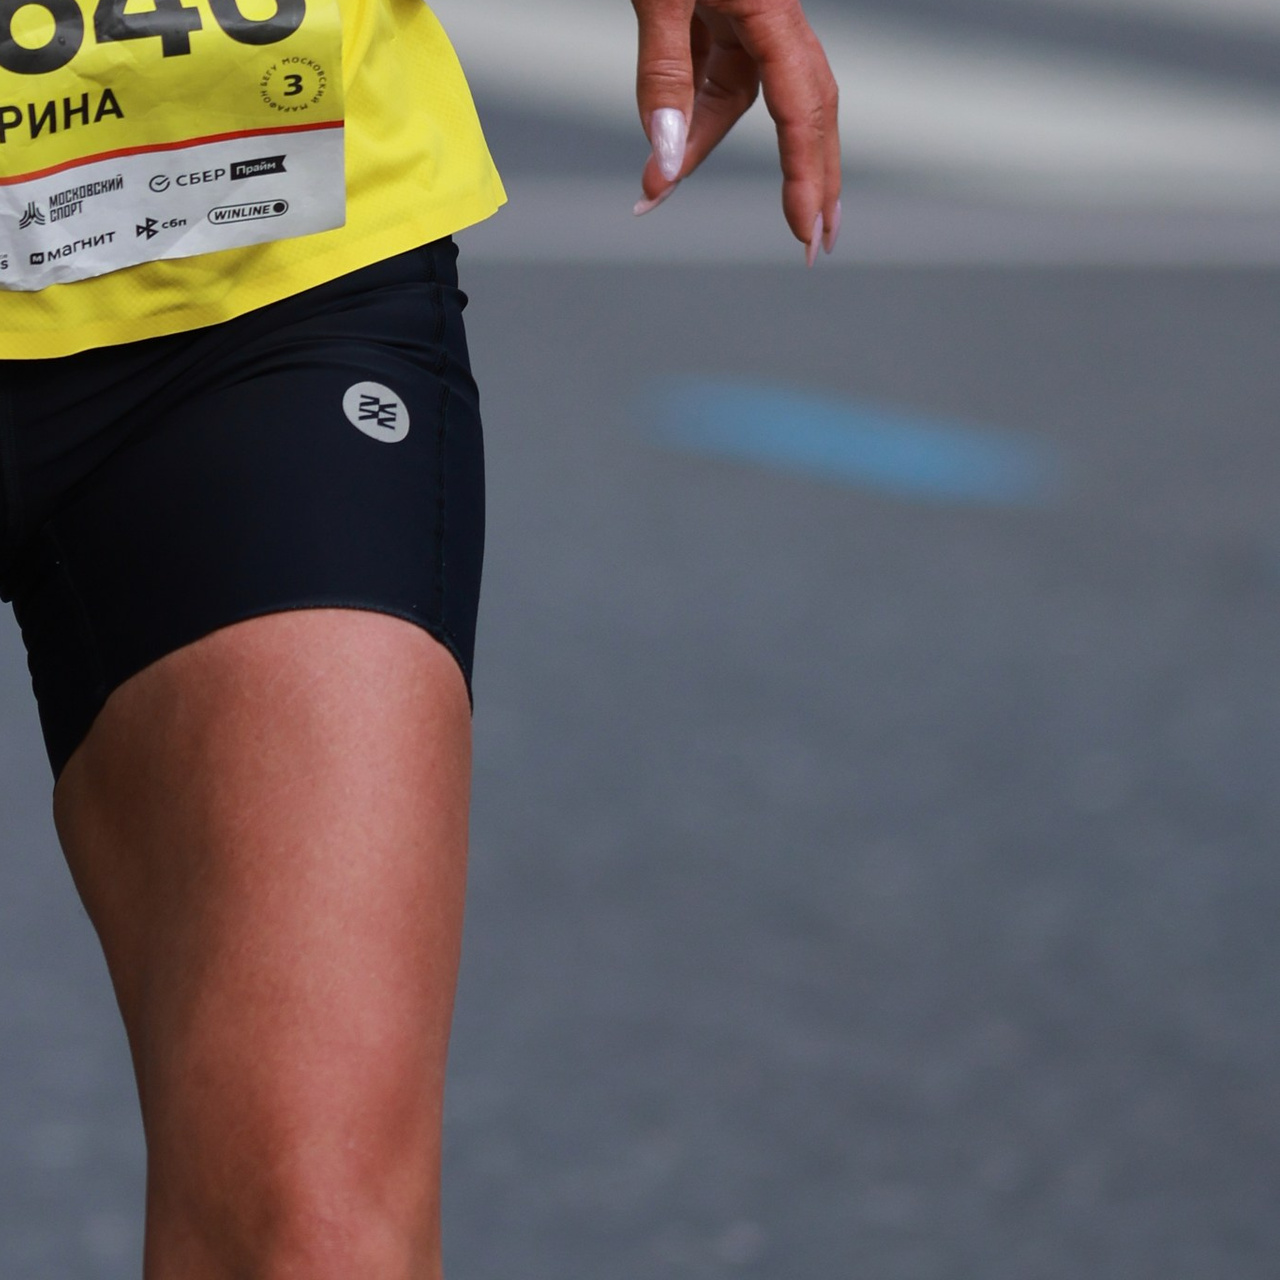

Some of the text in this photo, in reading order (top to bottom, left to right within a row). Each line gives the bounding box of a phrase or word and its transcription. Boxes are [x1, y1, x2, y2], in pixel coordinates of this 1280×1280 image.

[284, 74, 303, 96] 3
[176, 161, 276, 187] СБЕР Прайм
[49, 173, 124, 209] МОСКОВСКИЙ
[50, 200, 83, 223] СПОРТ
[214, 204, 271, 221] WINLINE
[161, 218, 187, 229] сбп
[47, 231, 116, 262] магнит
